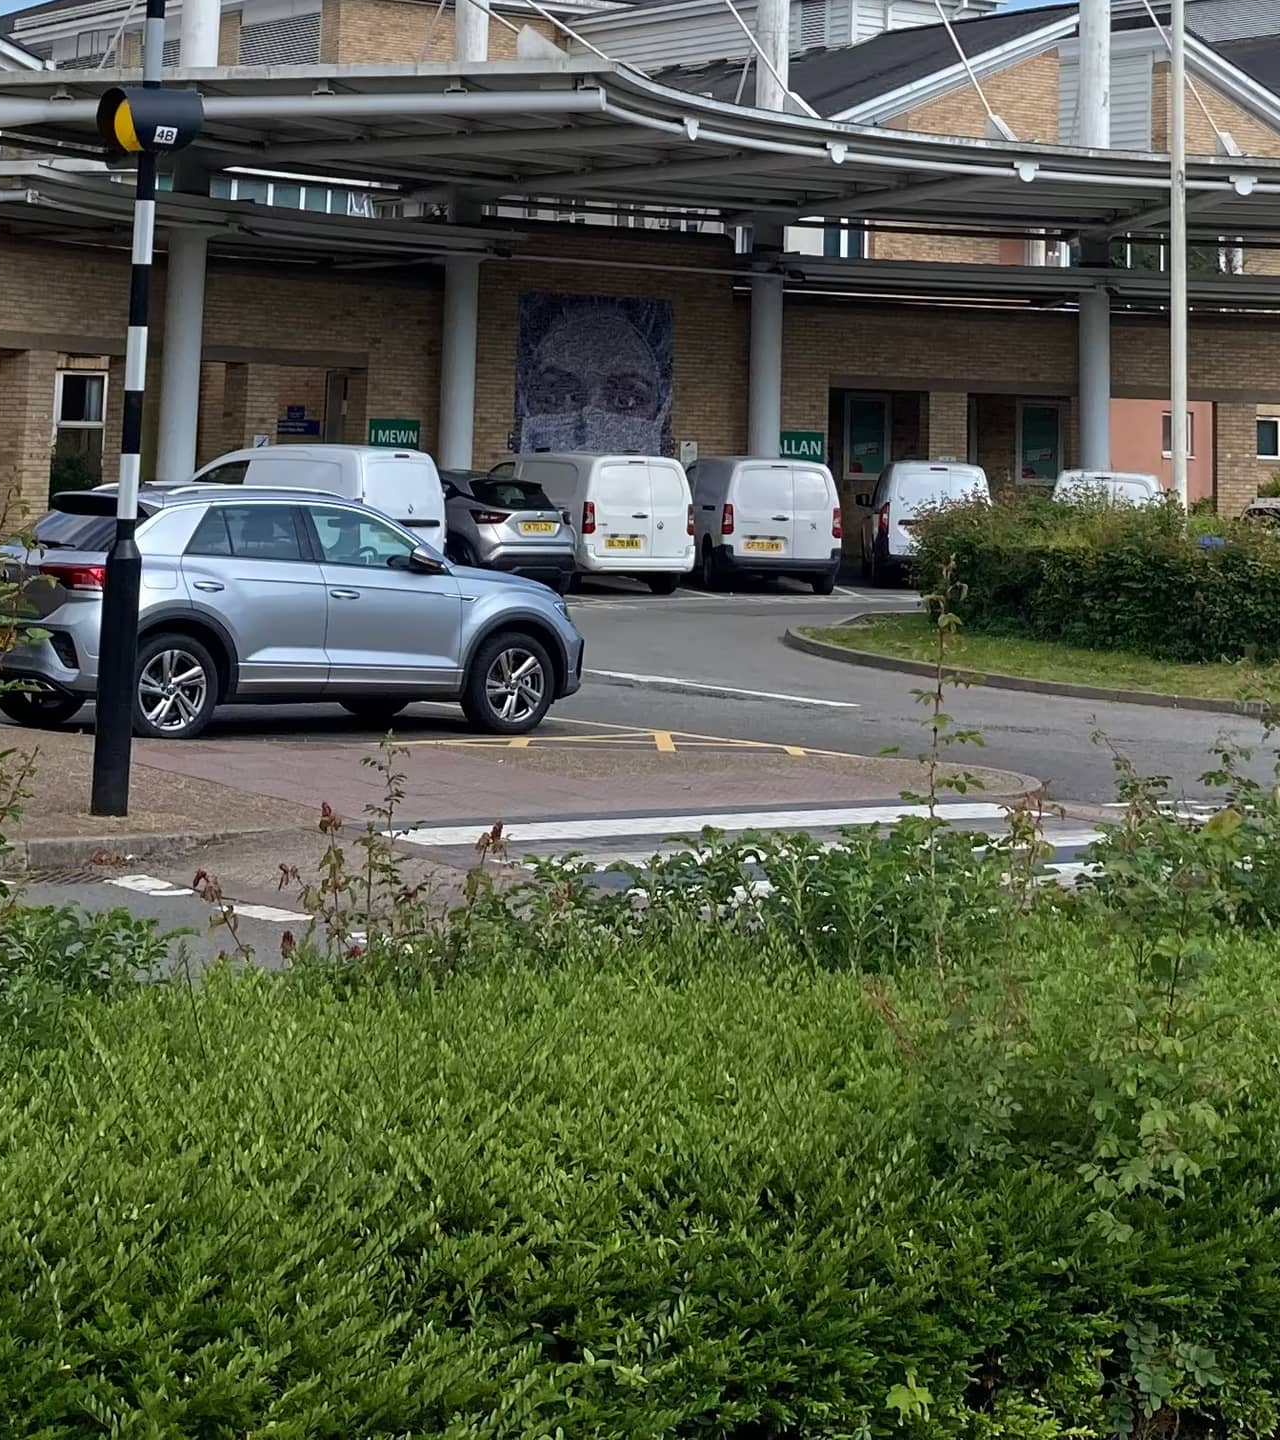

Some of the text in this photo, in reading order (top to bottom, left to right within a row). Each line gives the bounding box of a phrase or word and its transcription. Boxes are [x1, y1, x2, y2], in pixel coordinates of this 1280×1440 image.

[156, 129, 175, 142] 4B
[371, 429, 417, 443] I MEWN
